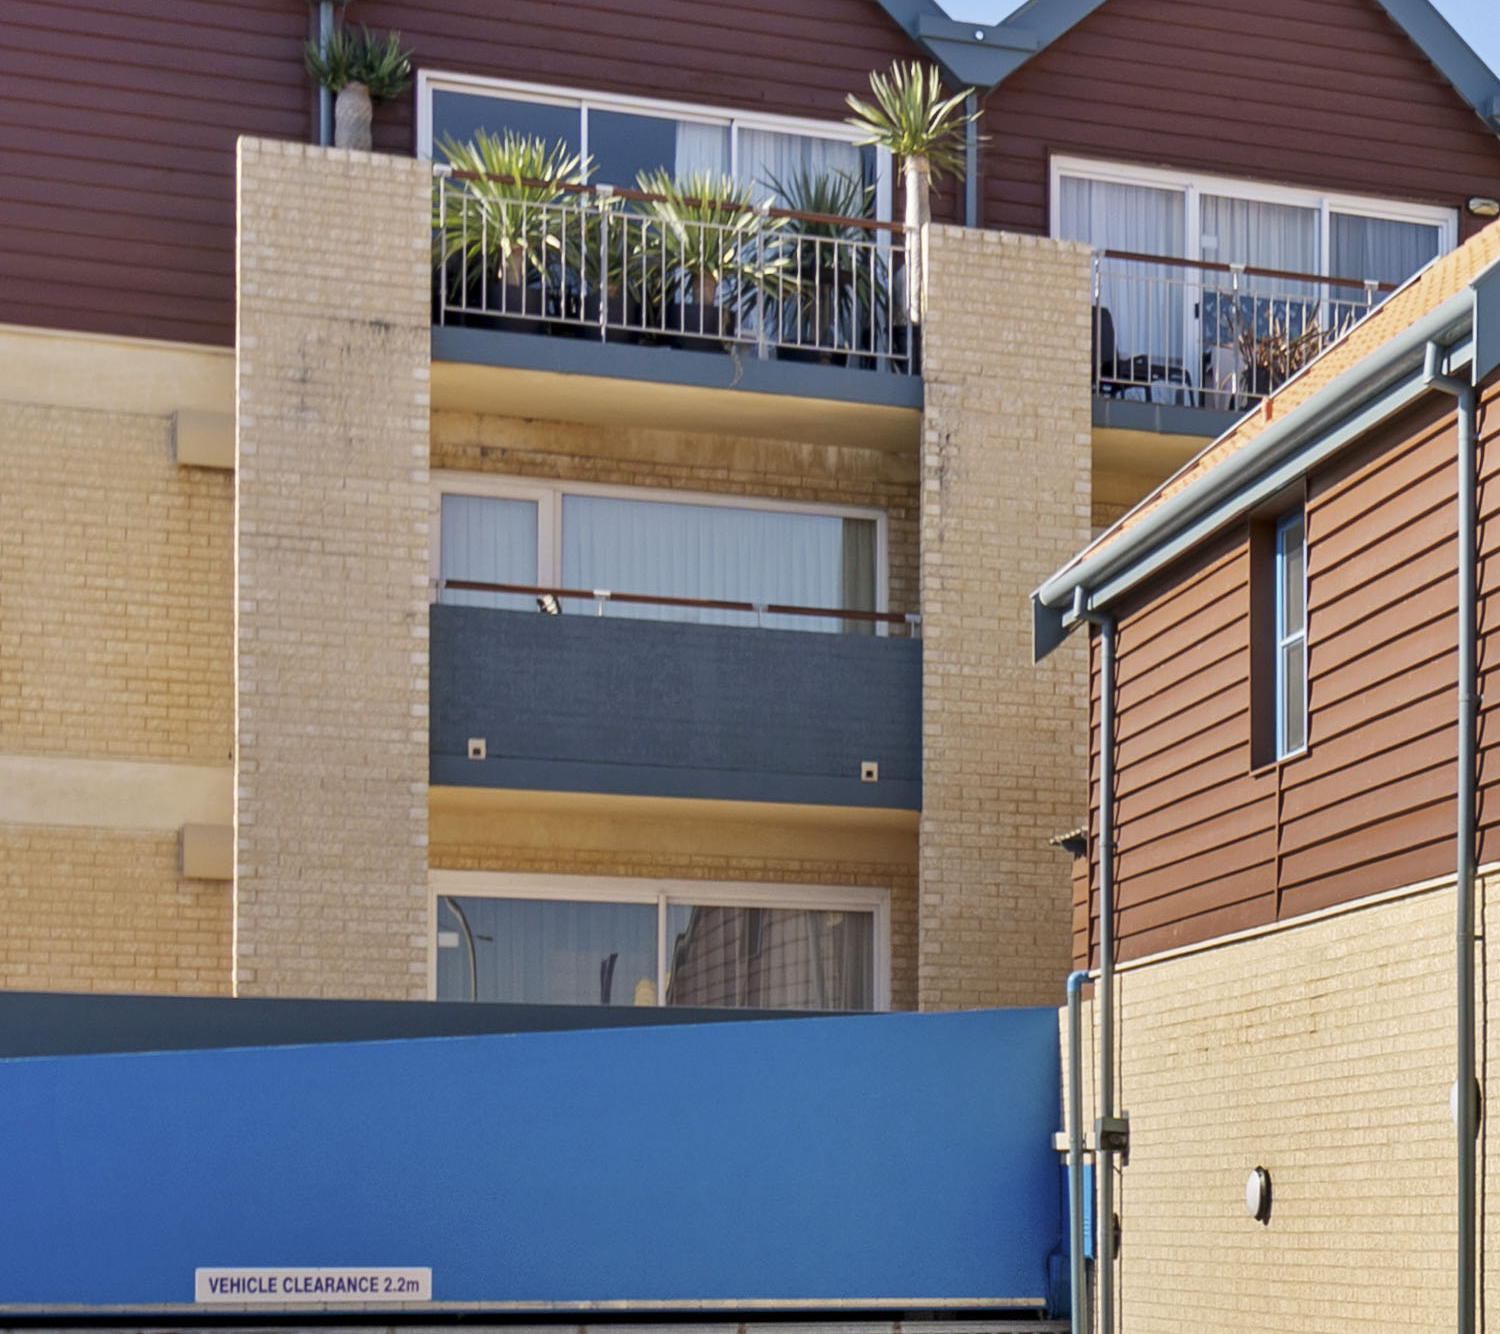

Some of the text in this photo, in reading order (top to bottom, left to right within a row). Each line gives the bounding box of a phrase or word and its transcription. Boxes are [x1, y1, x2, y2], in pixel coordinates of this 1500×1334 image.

[209, 1276, 420, 1293] VEHICLE CLEARANCE 2.2m
